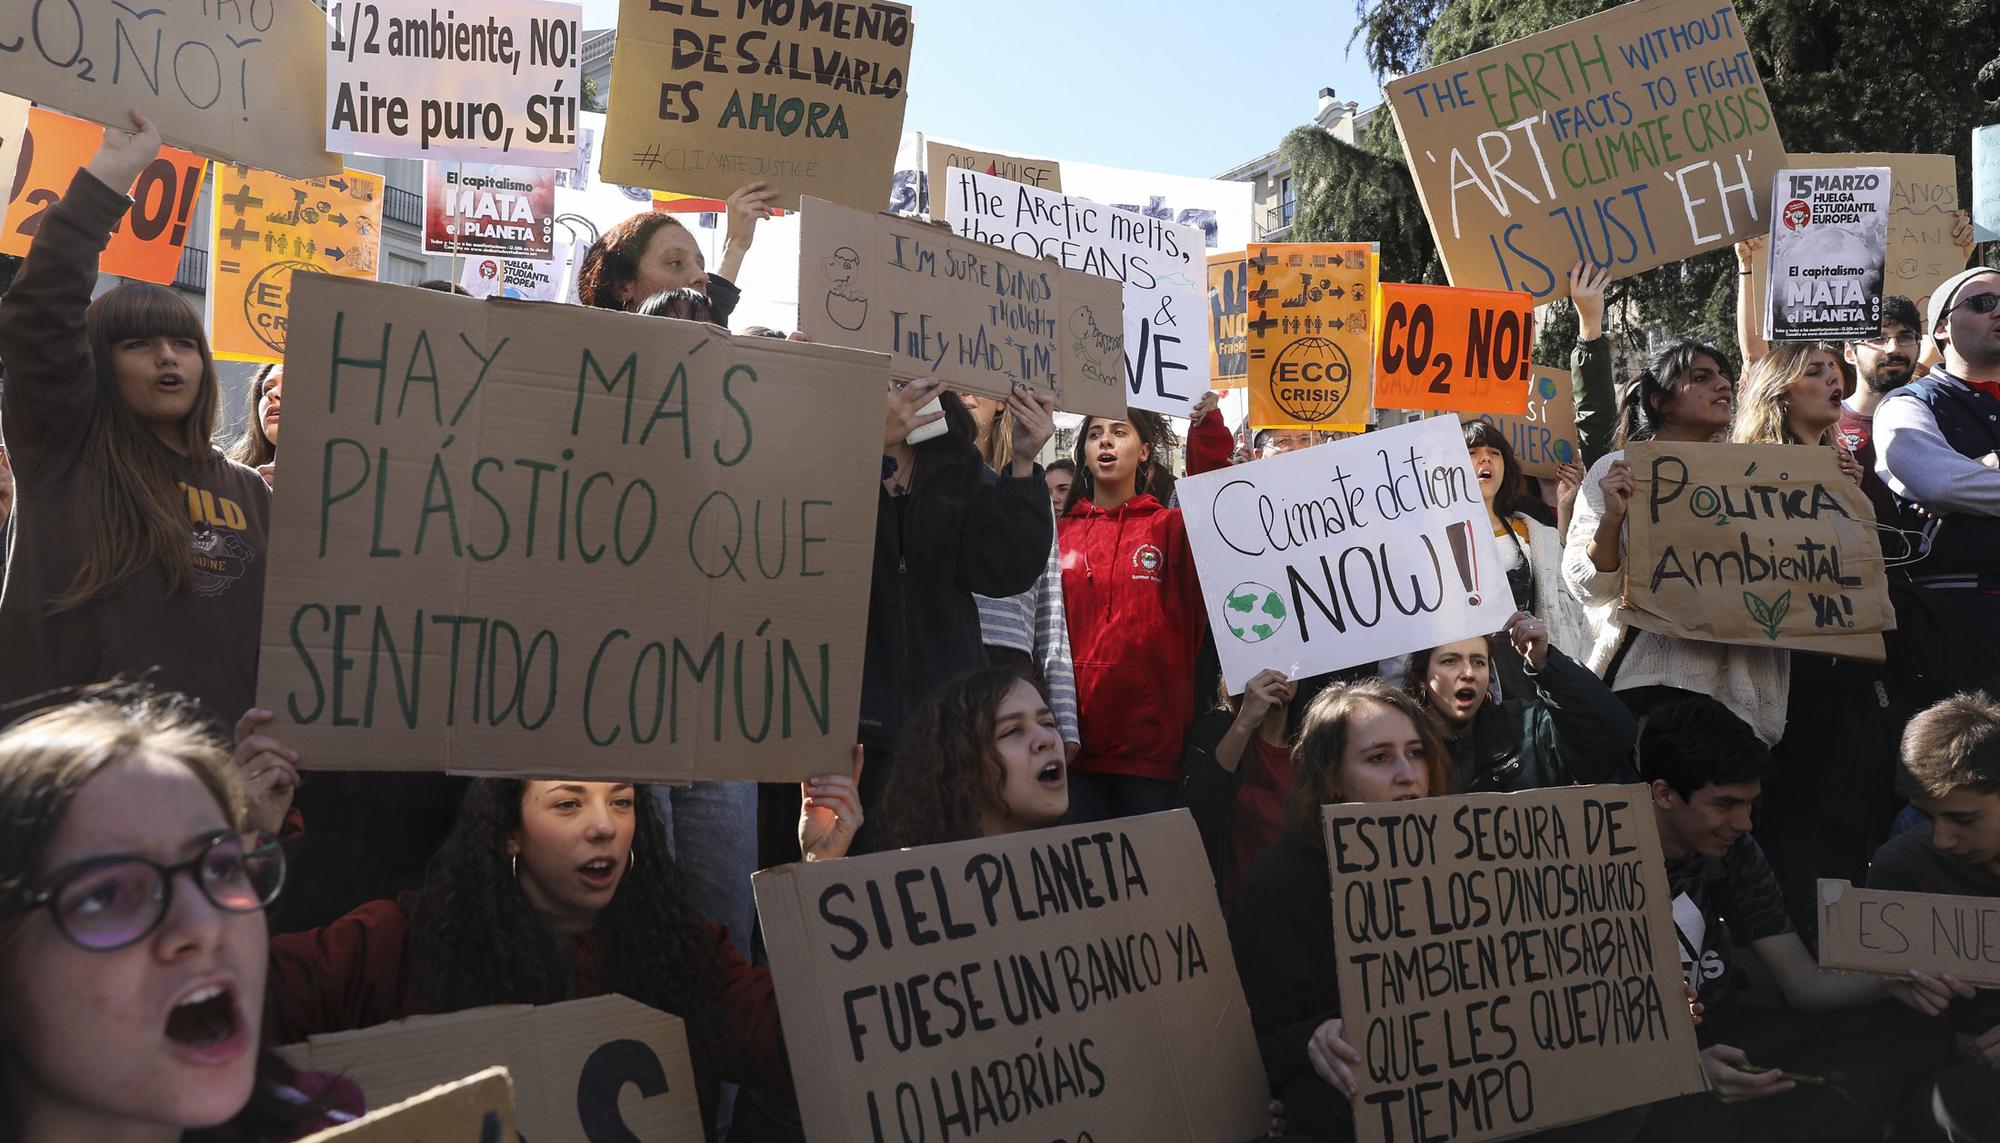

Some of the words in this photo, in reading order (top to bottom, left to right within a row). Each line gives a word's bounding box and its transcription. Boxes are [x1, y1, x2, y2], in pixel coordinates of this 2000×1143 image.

[331, 2, 380, 62] 1/2
[388, 8, 521, 75] ambiente,
[530, 18, 577, 68] NO!
[737, 0, 908, 47] MOMENTO
[672, 28, 728, 74] DE
[736, 31, 903, 99] SALVARLO
[1404, 71, 1476, 118] THE
[1476, 35, 1614, 128] EARTH
[1618, 7, 1736, 71] WITHOUT
[1642, 77, 1678, 110] TO
[1684, 52, 1756, 99] FIGHT
[331, 81, 408, 136] Aire
[421, 99, 514, 153] puro,
[526, 79, 576, 144] SÍ!
[659, 80, 704, 123] ES
[717, 88, 849, 139] AHORA
[1561, 115, 1683, 189] CLIMATE
[1682, 87, 1771, 153] CRISIS
[446, 188, 535, 224] MATA
[447, 171, 458, 185] El
[462, 175, 534, 192] capitalismo
[1789, 175, 1813, 199] 15
[1814, 174, 1880, 191] MARZO
[1812, 203, 1877, 214] ESTUDIANTIL
[1813, 193, 1855, 203] HUELGA
[464, 222, 535, 242] PLANETA
[959, 173, 1006, 218] the
[1111, 213, 1190, 264] melts,
[1489, 223, 1556, 297] IS
[1549, 183, 1658, 279] JUST
[1812, 214, 1861, 224] EUROPEA
[503, 266, 550, 284] STUDIANTIL
[1786, 279, 1866, 307] MATA
[1789, 266, 1799, 277] El
[1802, 265, 1865, 279] capitalismo
[988, 298, 1056, 339] THOUGHT
[1153, 295, 1177, 327] &
[1786, 310, 1799, 323] el
[1804, 309, 1866, 323] PLANETA
[959, 323, 1004, 371] HAD
[1279, 362, 1348, 383] ECO
[1464, 307, 1533, 381] NO!
[330, 311, 510, 427] HAY
[572, 337, 758, 467] MÁS
[1280, 388, 1340, 402] CRISIS
[178, 481, 248, 531] ILD
[688, 490, 833, 583] QUE
[1212, 464, 1368, 557] Climate
[1807, 592, 1855, 628] YA!
[287, 602, 560, 731] SENTIDO
[583, 617, 830, 748] COMÚN
[1332, 814, 1438, 874] ESTOY
[1453, 805, 1570, 862] SEGURA
[1584, 800, 1637, 856] DE
[964, 832, 1149, 927] PLANETA
[1345, 878, 1417, 943] QUE
[1423, 870, 1491, 936] LOS
[1495, 860, 1646, 927] DINOSAURIOS
[1859, 901, 1909, 954] ES
[1931, 906, 2000, 964] NUE
[844, 962, 996, 1062] FUESE
[997, 950, 1061, 1027] UN
[1056, 932, 1162, 1012] BANCO
[1166, 922, 1209, 985] YA
[1350, 934, 1499, 1013] TAMBIEN
[1502, 915, 1654, 987] PENSABAN
[1366, 1011, 1439, 1084] QUE
[1445, 996, 1517, 1069] LES
[1530, 975, 1669, 1052] QUEDABA
[931, 1036, 1105, 1143] HABRÍAIS
[1365, 1060, 1534, 1143] TIEMPO
